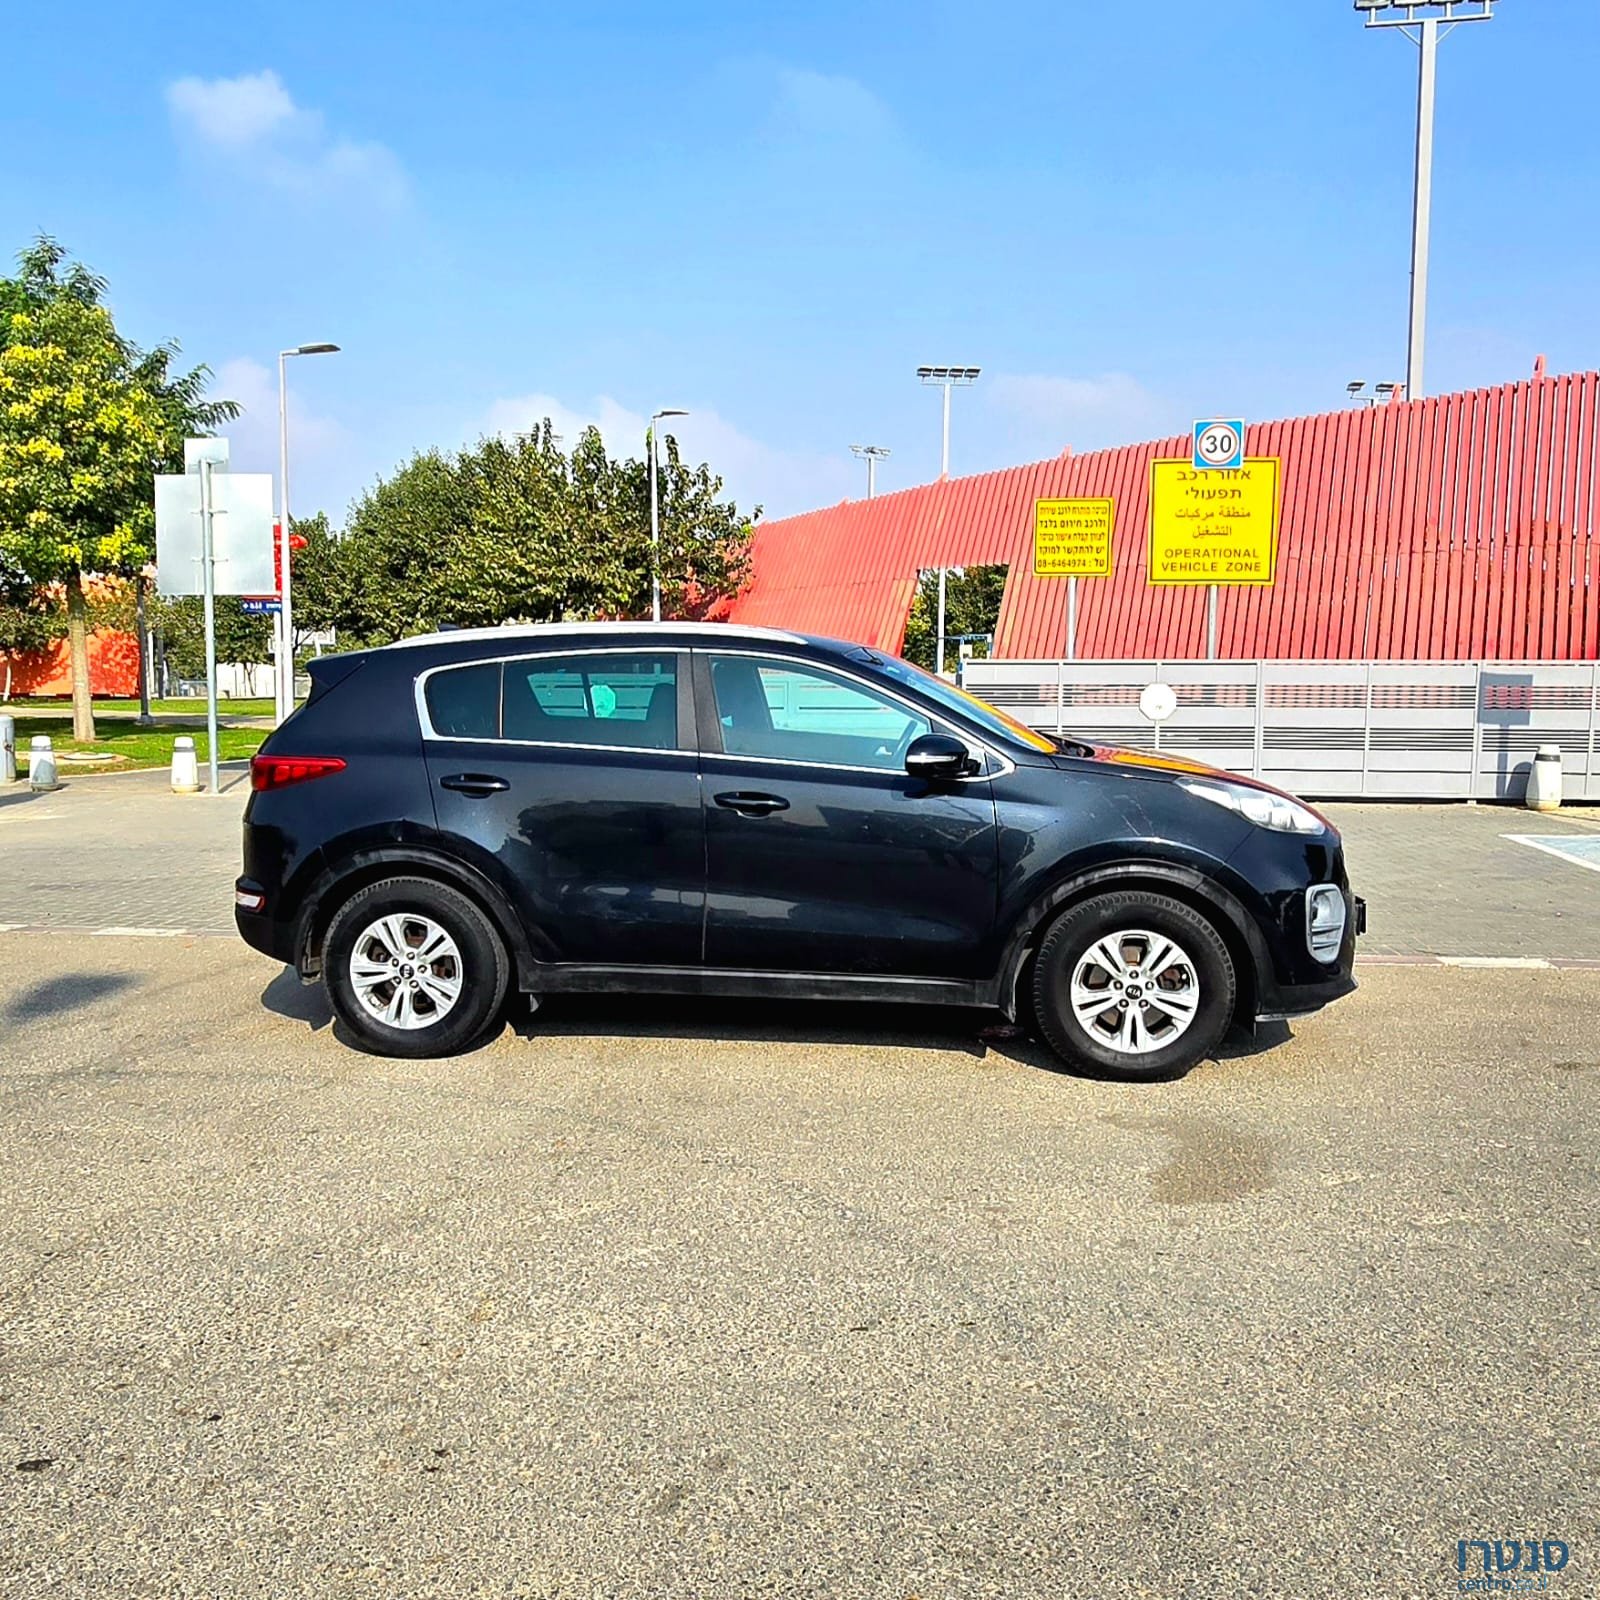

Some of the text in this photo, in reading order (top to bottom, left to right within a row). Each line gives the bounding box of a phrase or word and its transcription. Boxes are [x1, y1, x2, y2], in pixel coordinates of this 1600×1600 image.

[1205, 435, 1232, 454] 30
[1177, 469, 1251, 481] אזור רכב
[1185, 486, 1242, 500] תפעולי
[1175, 505, 1251, 521] منطقة مركبات
[1039, 518, 1057, 528] בלבד
[1192, 525, 1232, 539] التشغيل
[1164, 548, 1260, 559] OPERATIONAL
[1037, 558, 1086, 568] 08-6464974
[1161, 562, 1261, 573] VEHICLE ZONE
